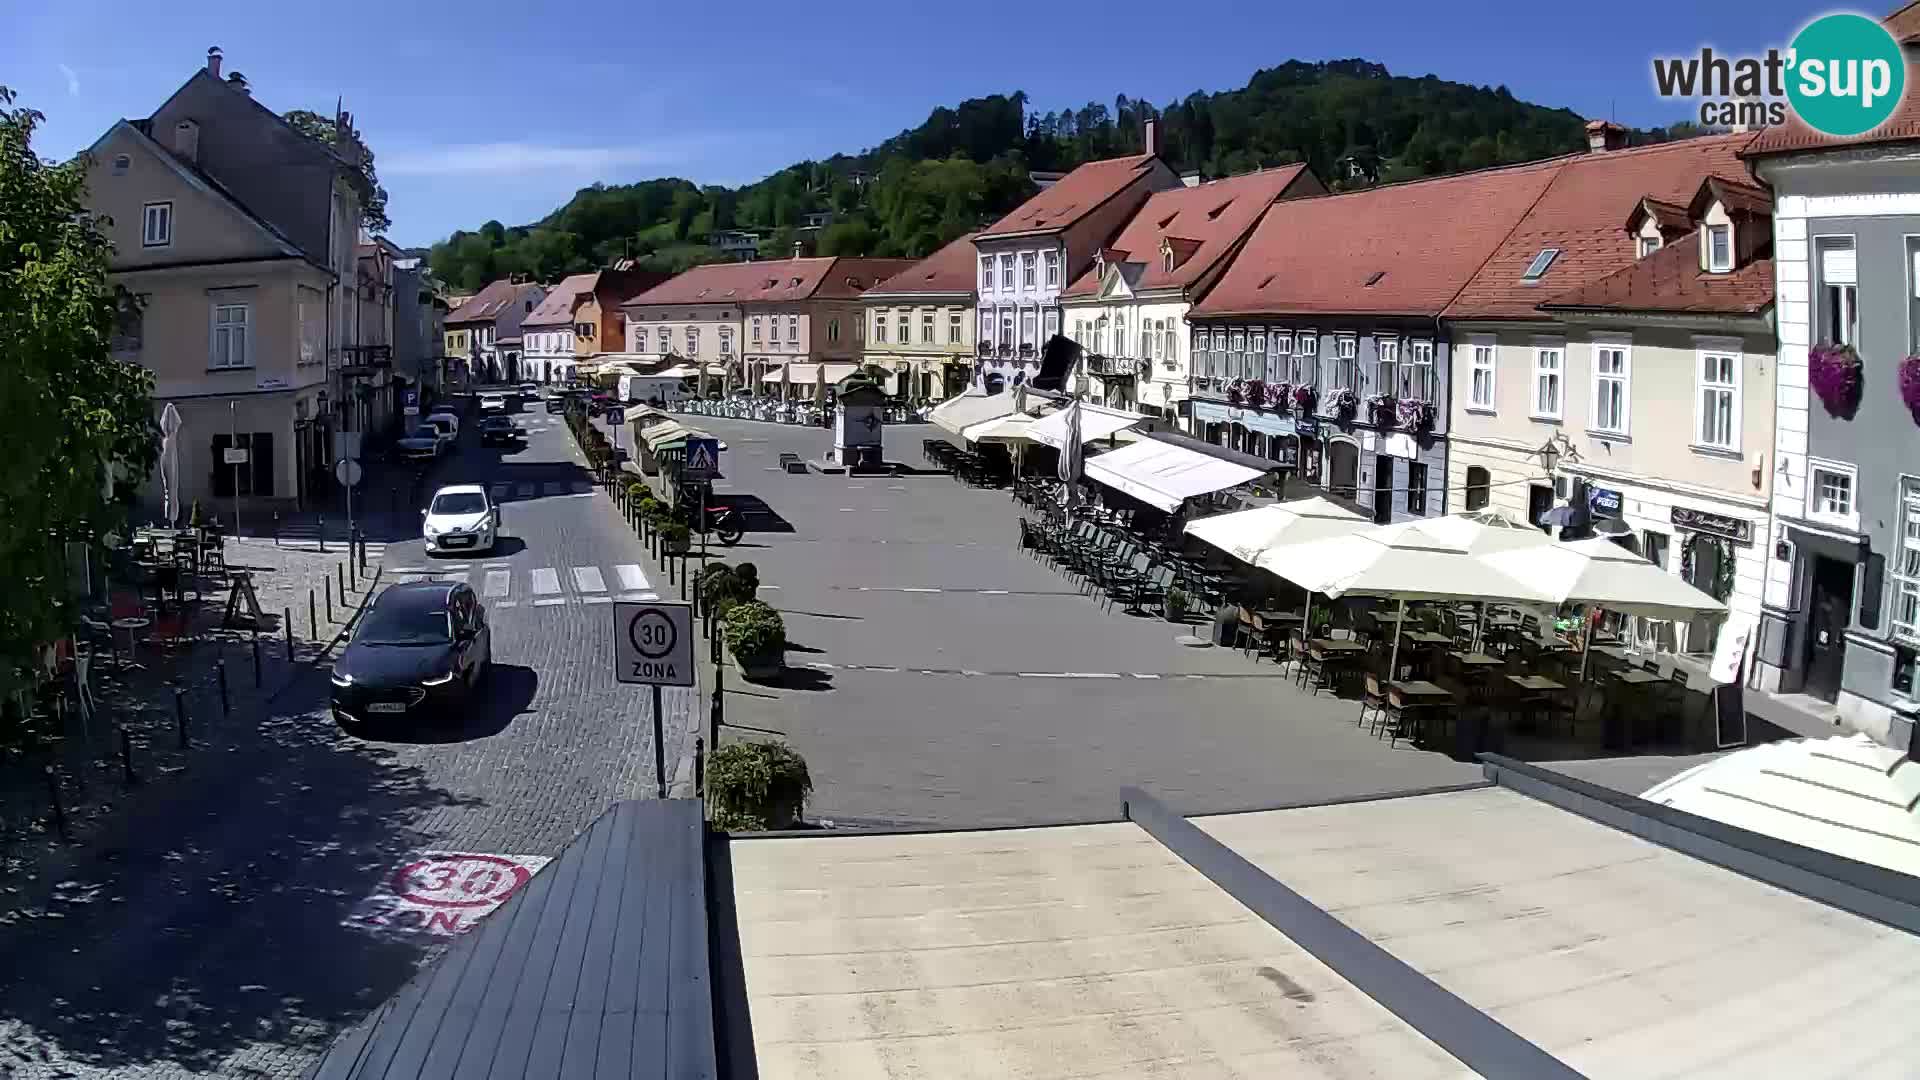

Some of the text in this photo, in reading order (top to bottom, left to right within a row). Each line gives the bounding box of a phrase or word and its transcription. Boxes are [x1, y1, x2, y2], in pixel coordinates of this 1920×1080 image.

[407, 393, 416, 404] P
[641, 624, 666, 646] 30
[632, 661, 677, 678] ZONA
[417, 866, 503, 894] 30
